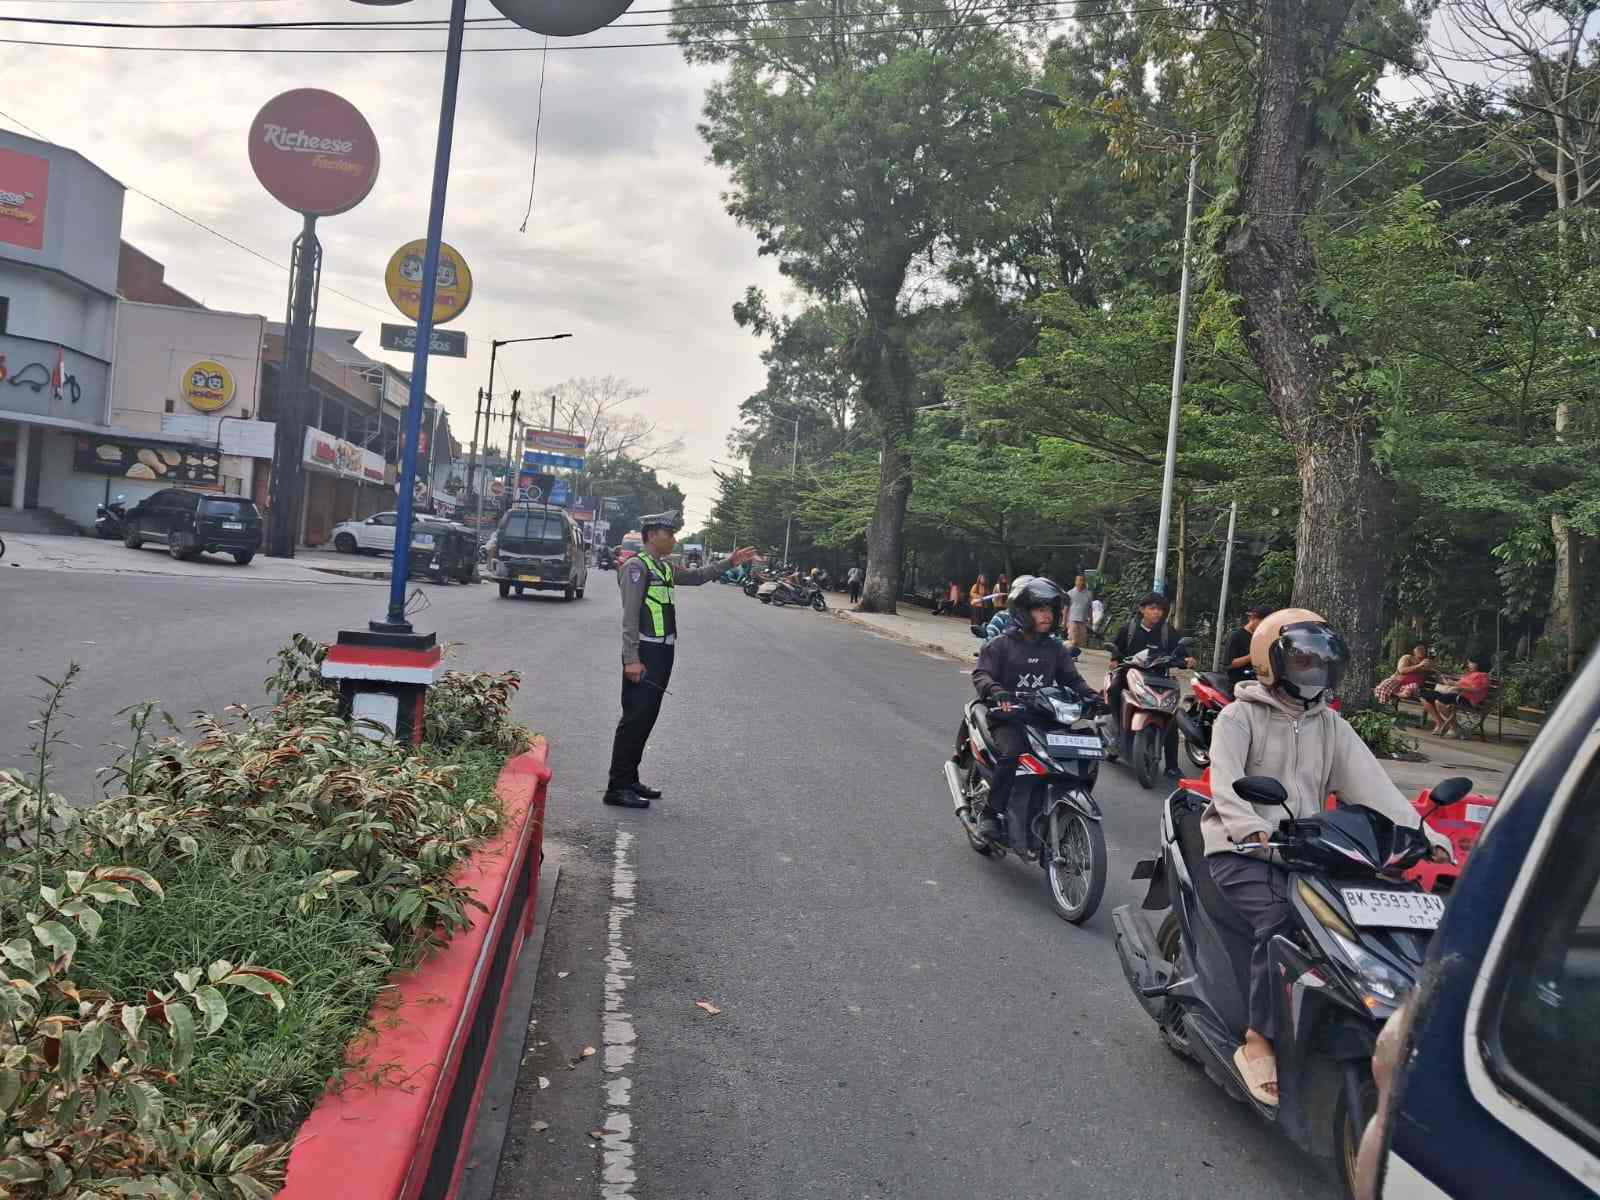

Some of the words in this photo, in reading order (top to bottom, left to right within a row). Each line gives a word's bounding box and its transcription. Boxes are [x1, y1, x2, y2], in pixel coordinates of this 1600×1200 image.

[263, 124, 353, 155] Richeese
[1345, 891, 1368, 906] BK
[1370, 892, 1411, 909] 5593
